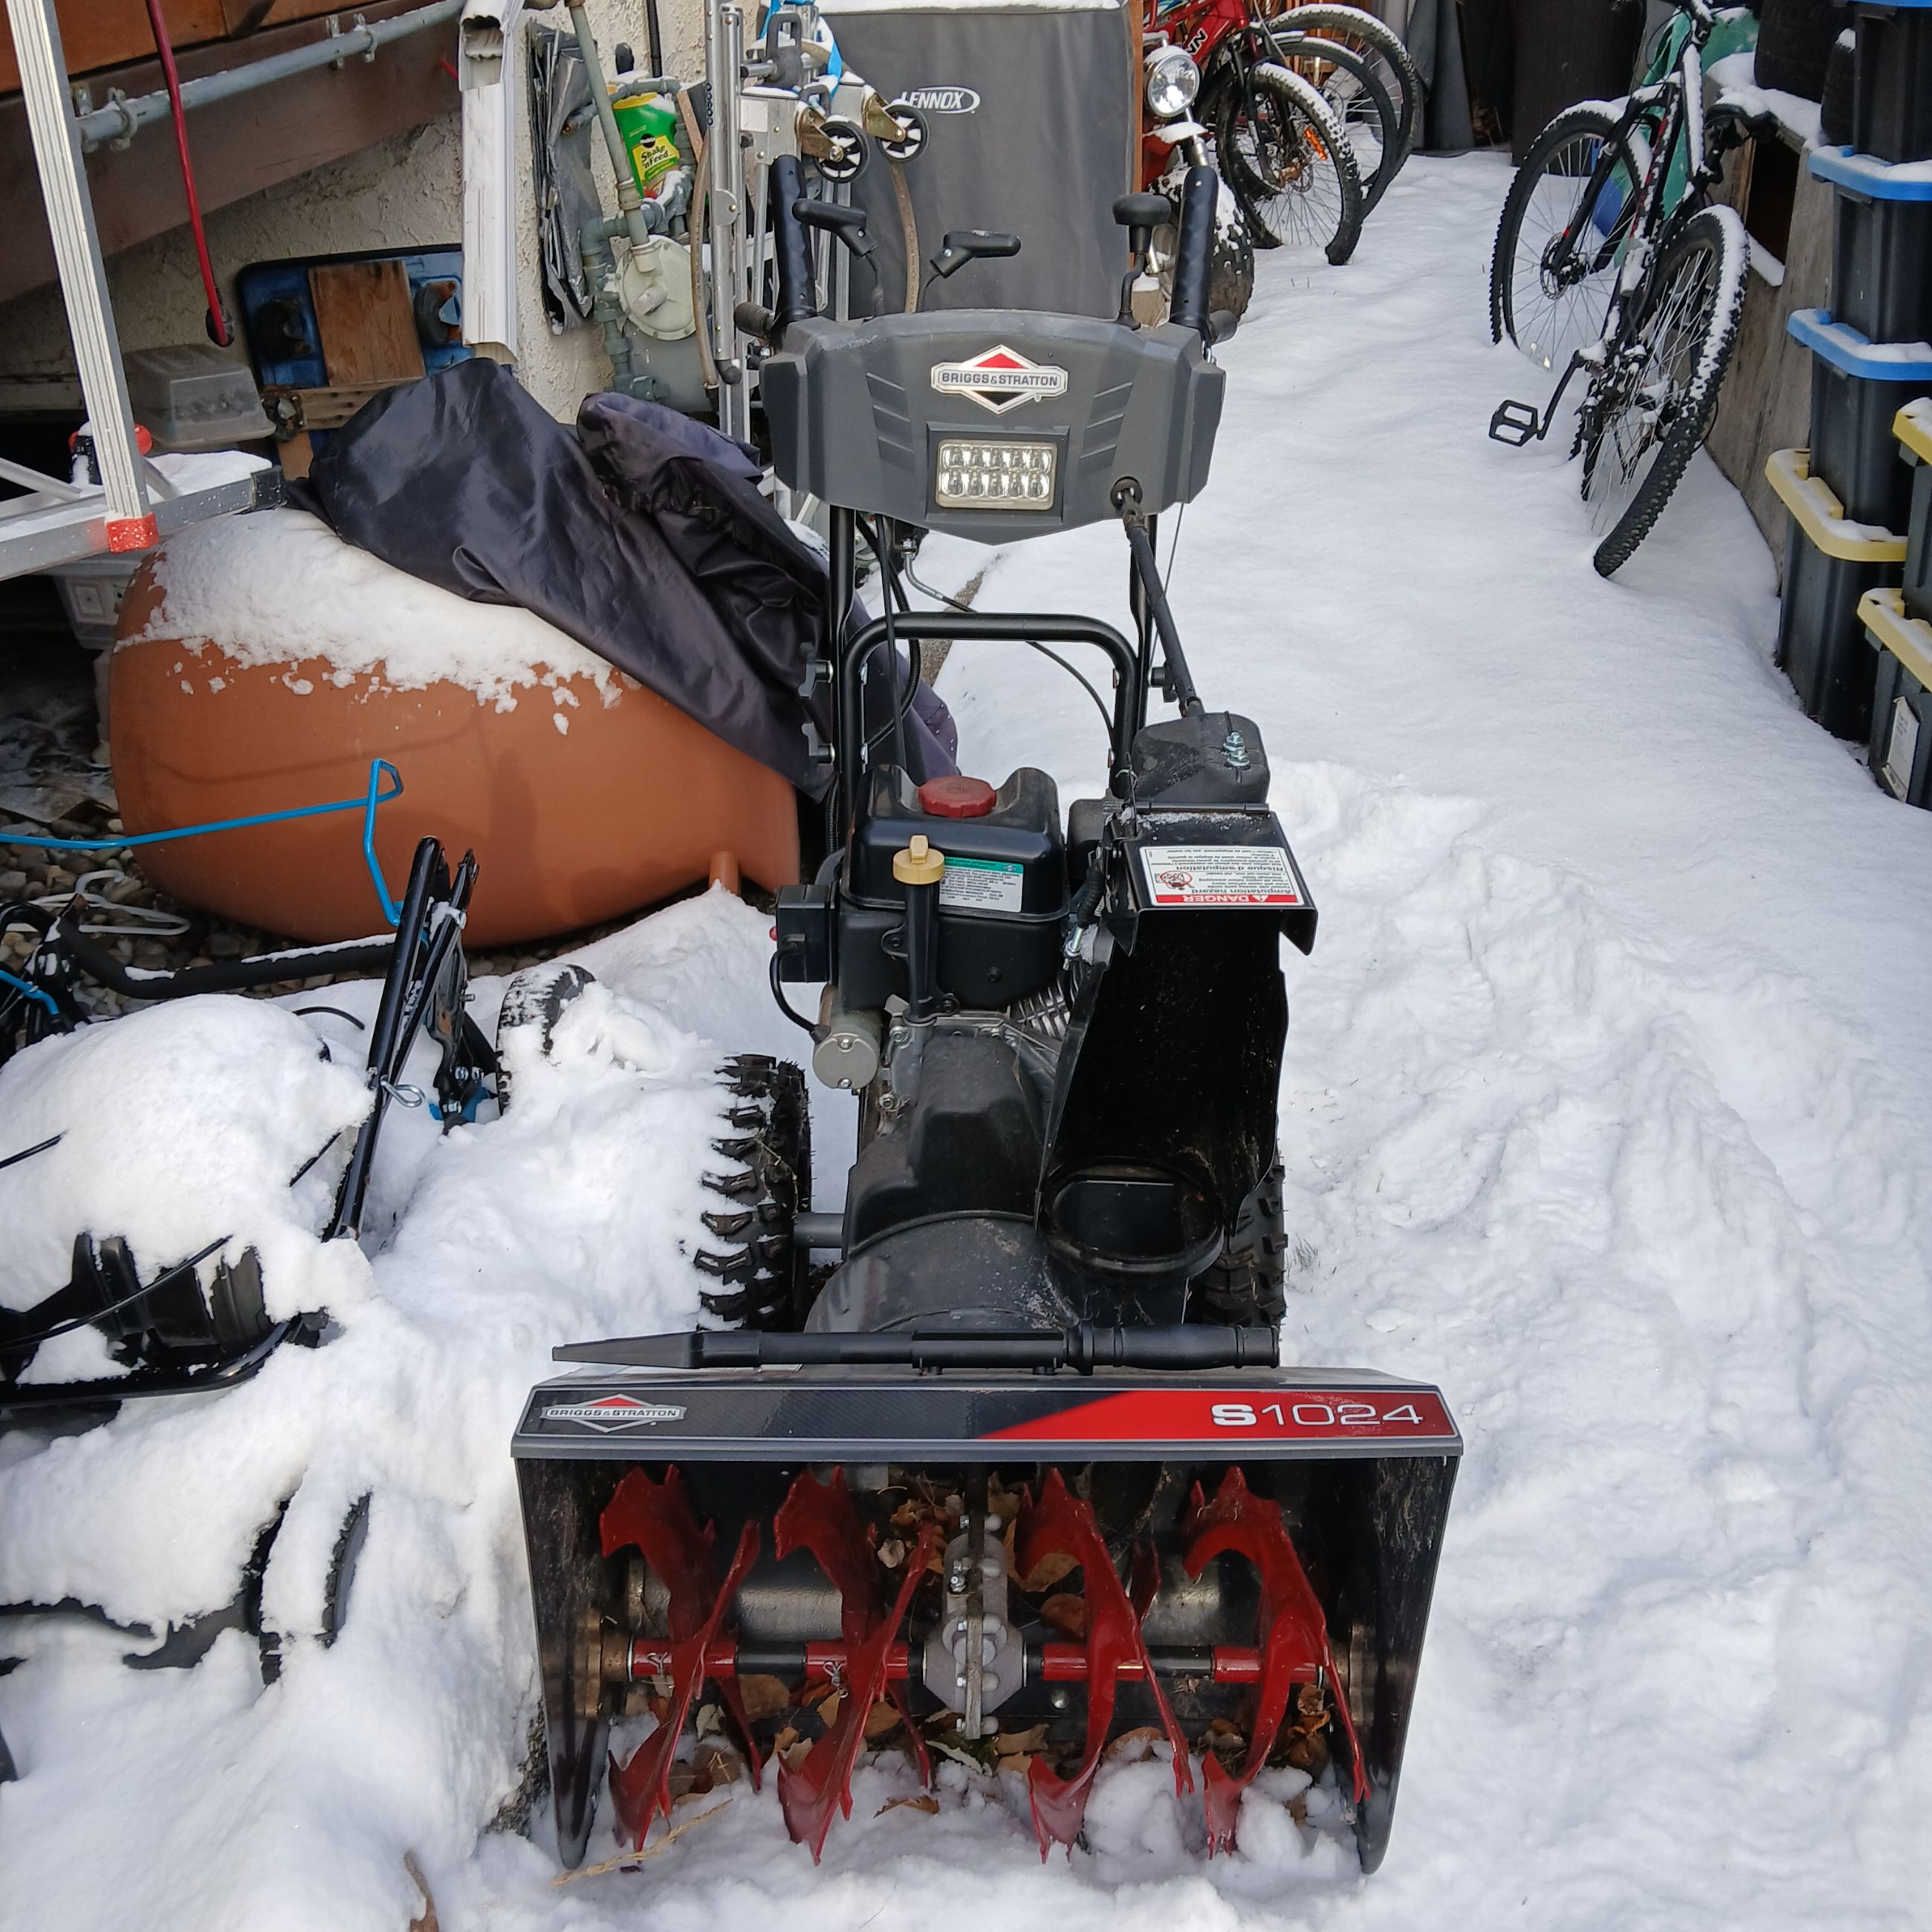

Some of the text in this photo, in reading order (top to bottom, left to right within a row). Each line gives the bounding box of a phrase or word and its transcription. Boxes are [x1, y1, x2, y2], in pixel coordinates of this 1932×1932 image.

[641, 145, 666, 163] Shake
[1183, 895, 1250, 903] DANGER
[1210, 1403, 1424, 1426] S1024
